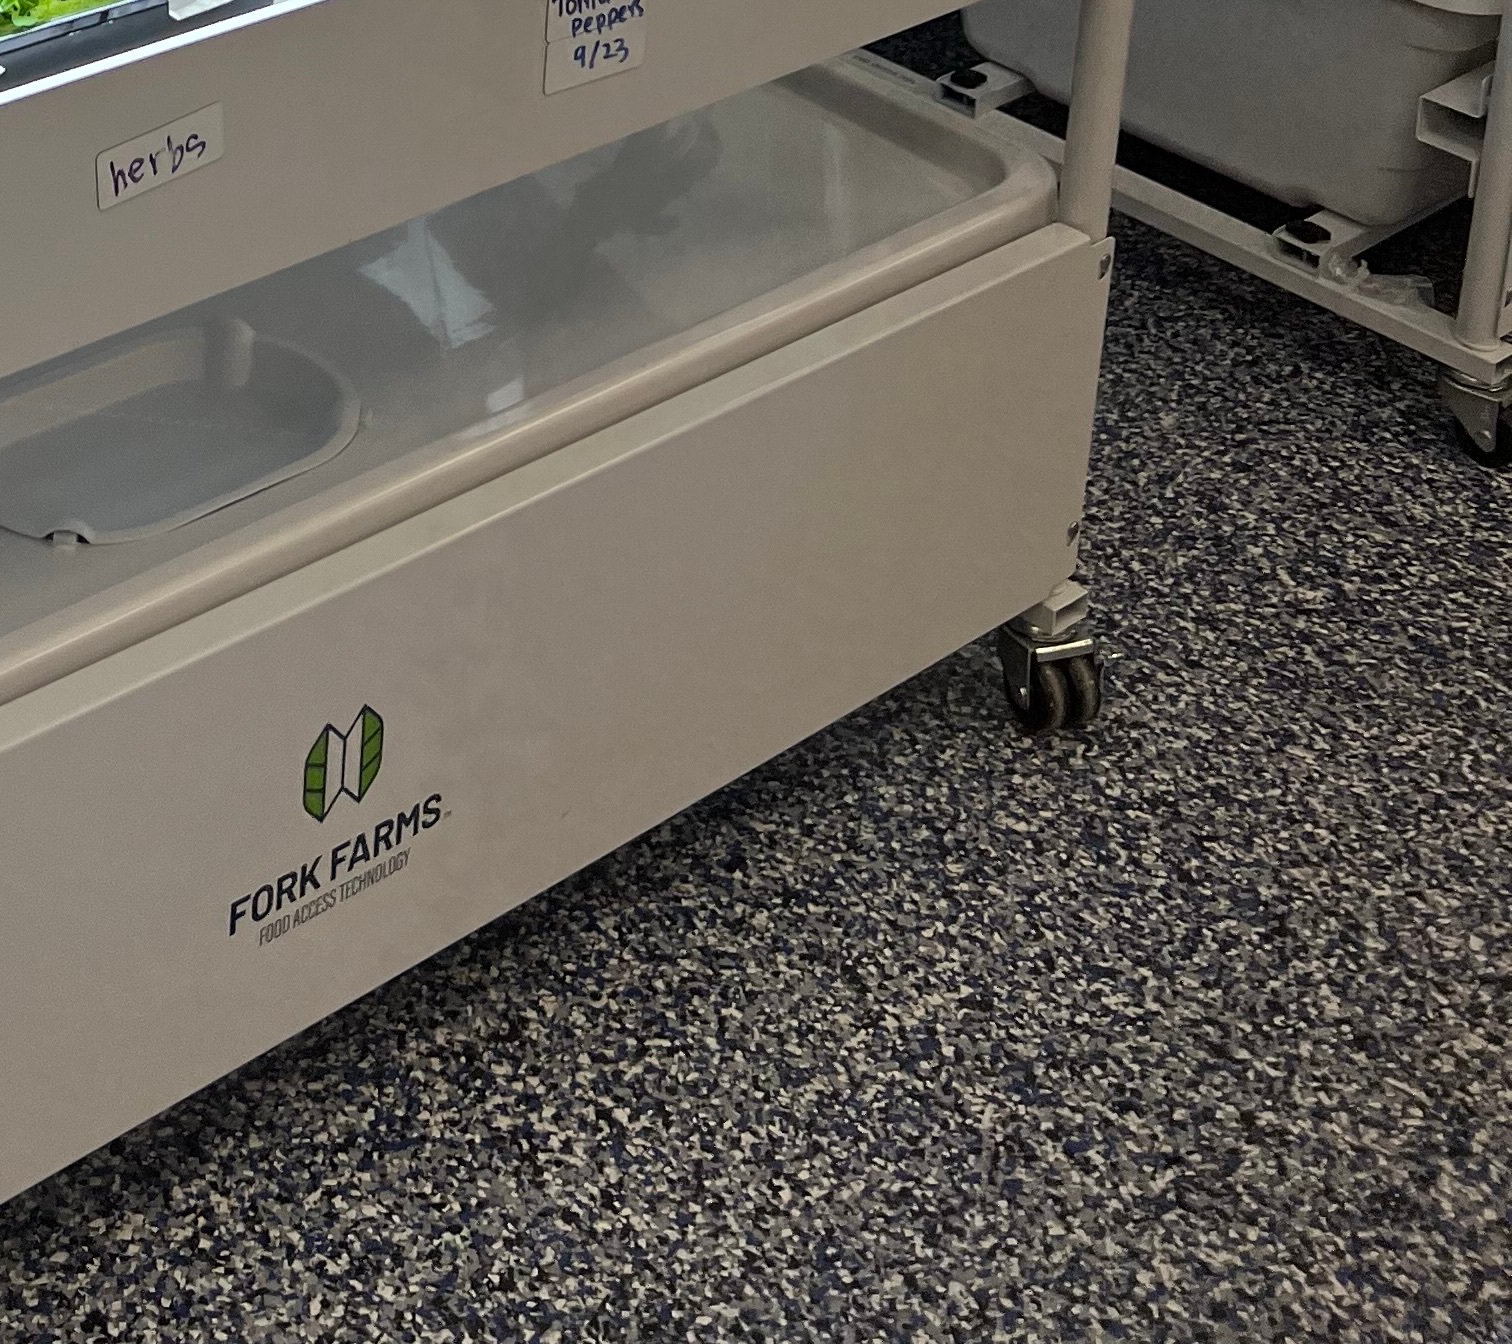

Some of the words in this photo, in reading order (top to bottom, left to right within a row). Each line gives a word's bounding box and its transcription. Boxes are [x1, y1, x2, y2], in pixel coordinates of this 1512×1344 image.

[573, 38, 629, 69] 9/23
[110, 133, 206, 197] herbs
[229, 854, 323, 936] FORK
[330, 793, 442, 881] FARMS
[259, 914, 291, 947] FOOD
[292, 888, 337, 928] ACCESS
[339, 847, 411, 902] TECHNOLOGY
